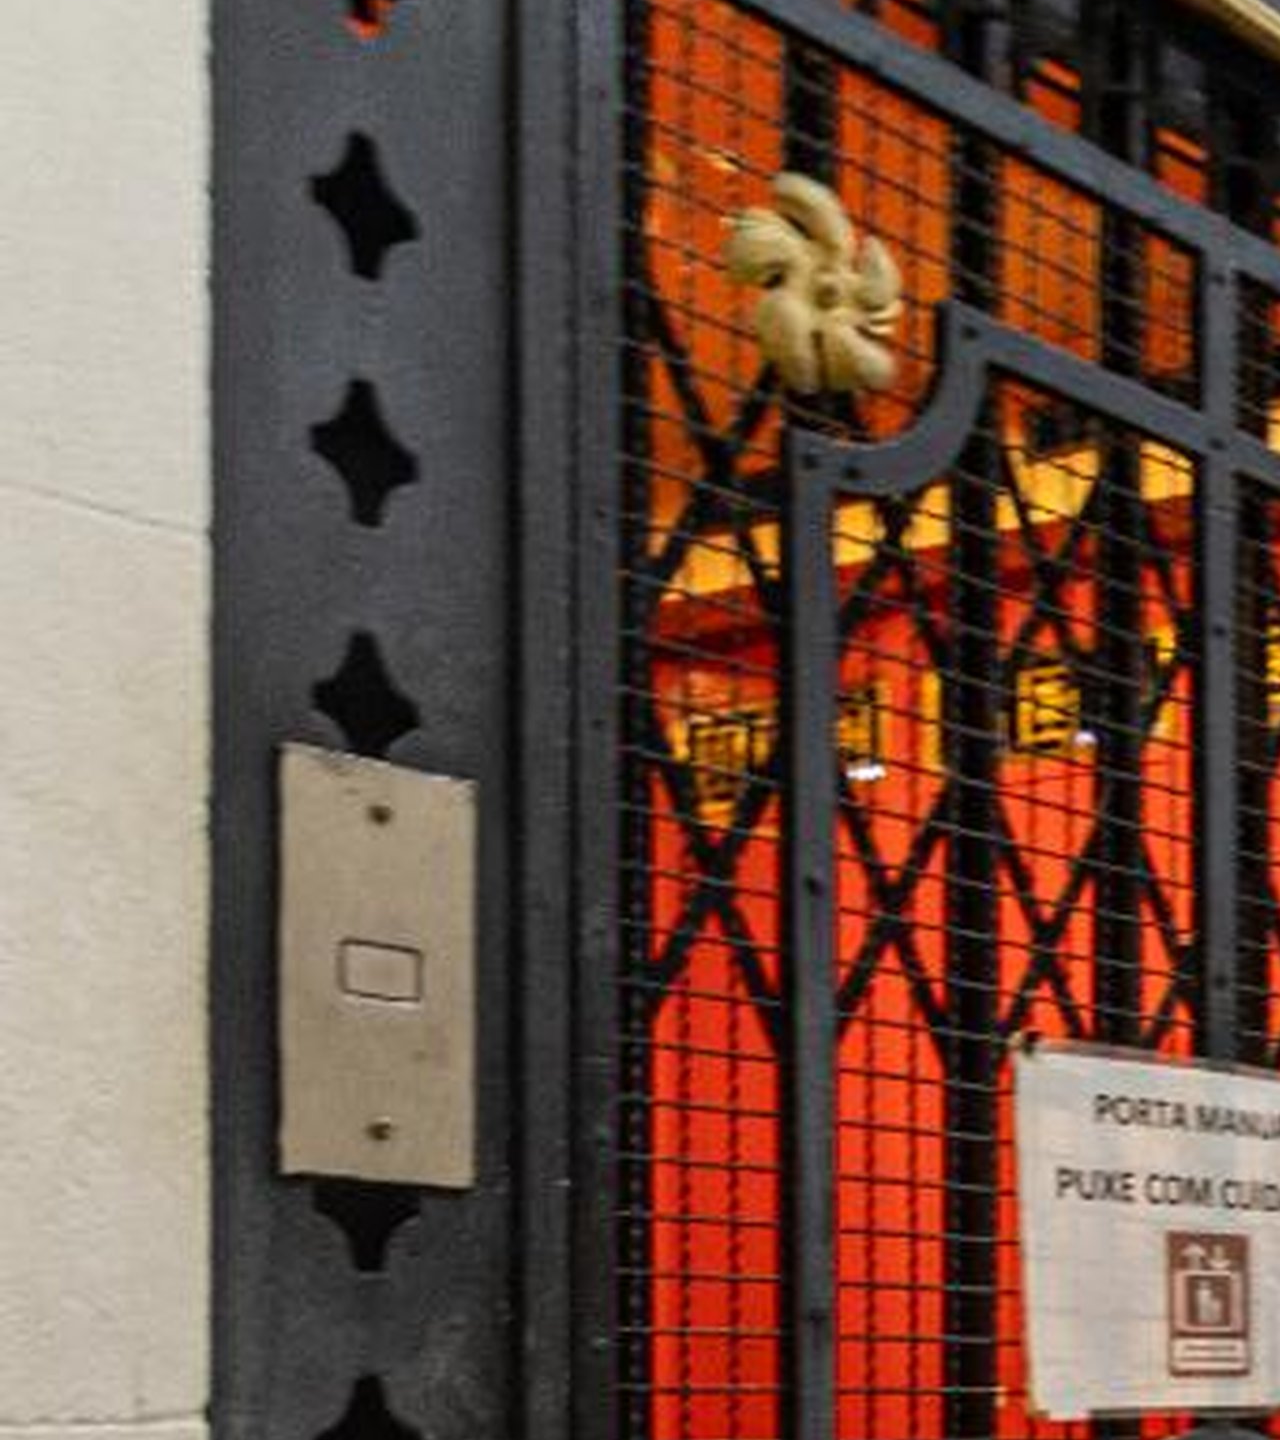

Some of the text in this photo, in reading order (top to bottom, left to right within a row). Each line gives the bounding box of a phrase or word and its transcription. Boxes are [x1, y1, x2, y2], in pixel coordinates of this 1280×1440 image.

[1094, 1093, 1187, 1130] PORTA
[1056, 1167, 1136, 1203] PUXE
[1145, 1172, 1212, 1207] COM
